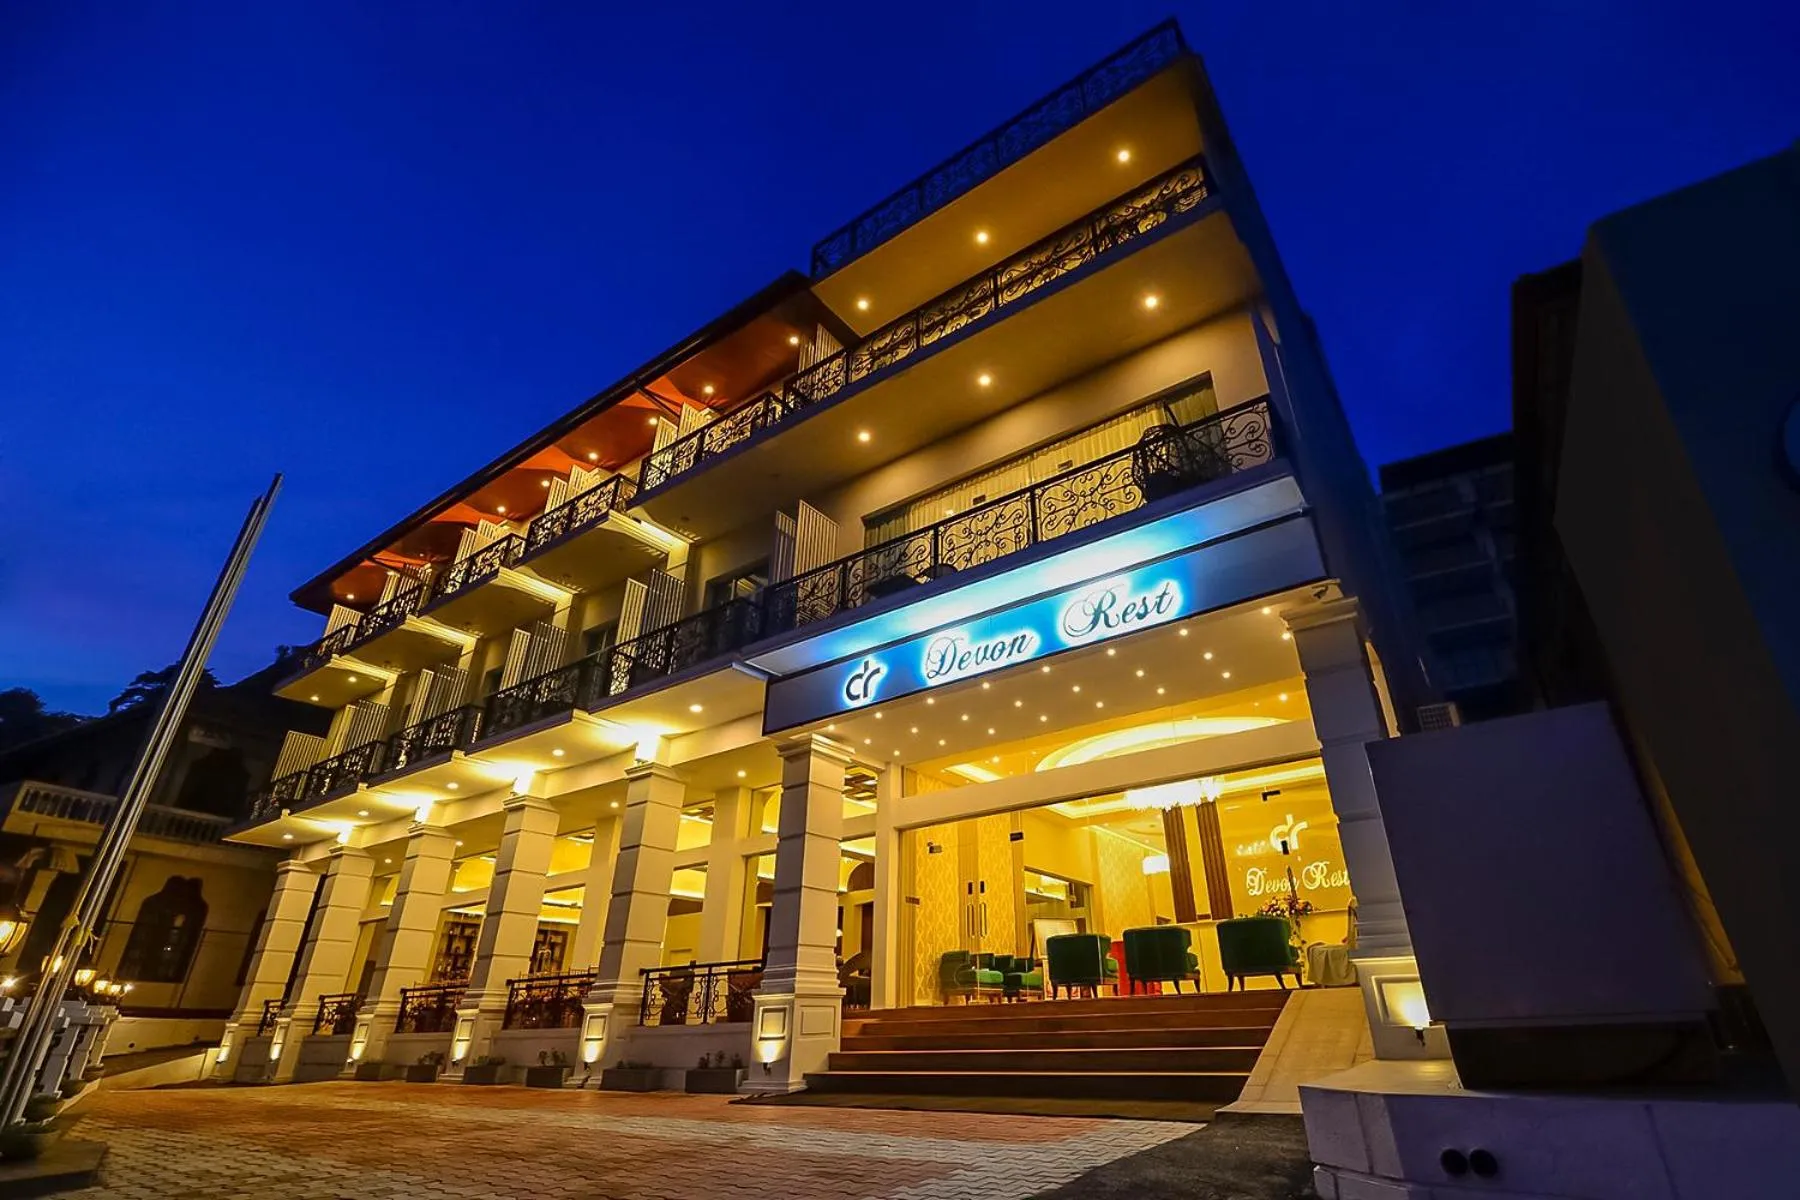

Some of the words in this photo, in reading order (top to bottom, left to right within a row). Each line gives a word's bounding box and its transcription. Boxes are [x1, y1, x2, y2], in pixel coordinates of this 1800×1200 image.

[926, 634, 1033, 680] Devon
[1063, 582, 1174, 637] Rest
[1302, 861, 1350, 890] Rest
